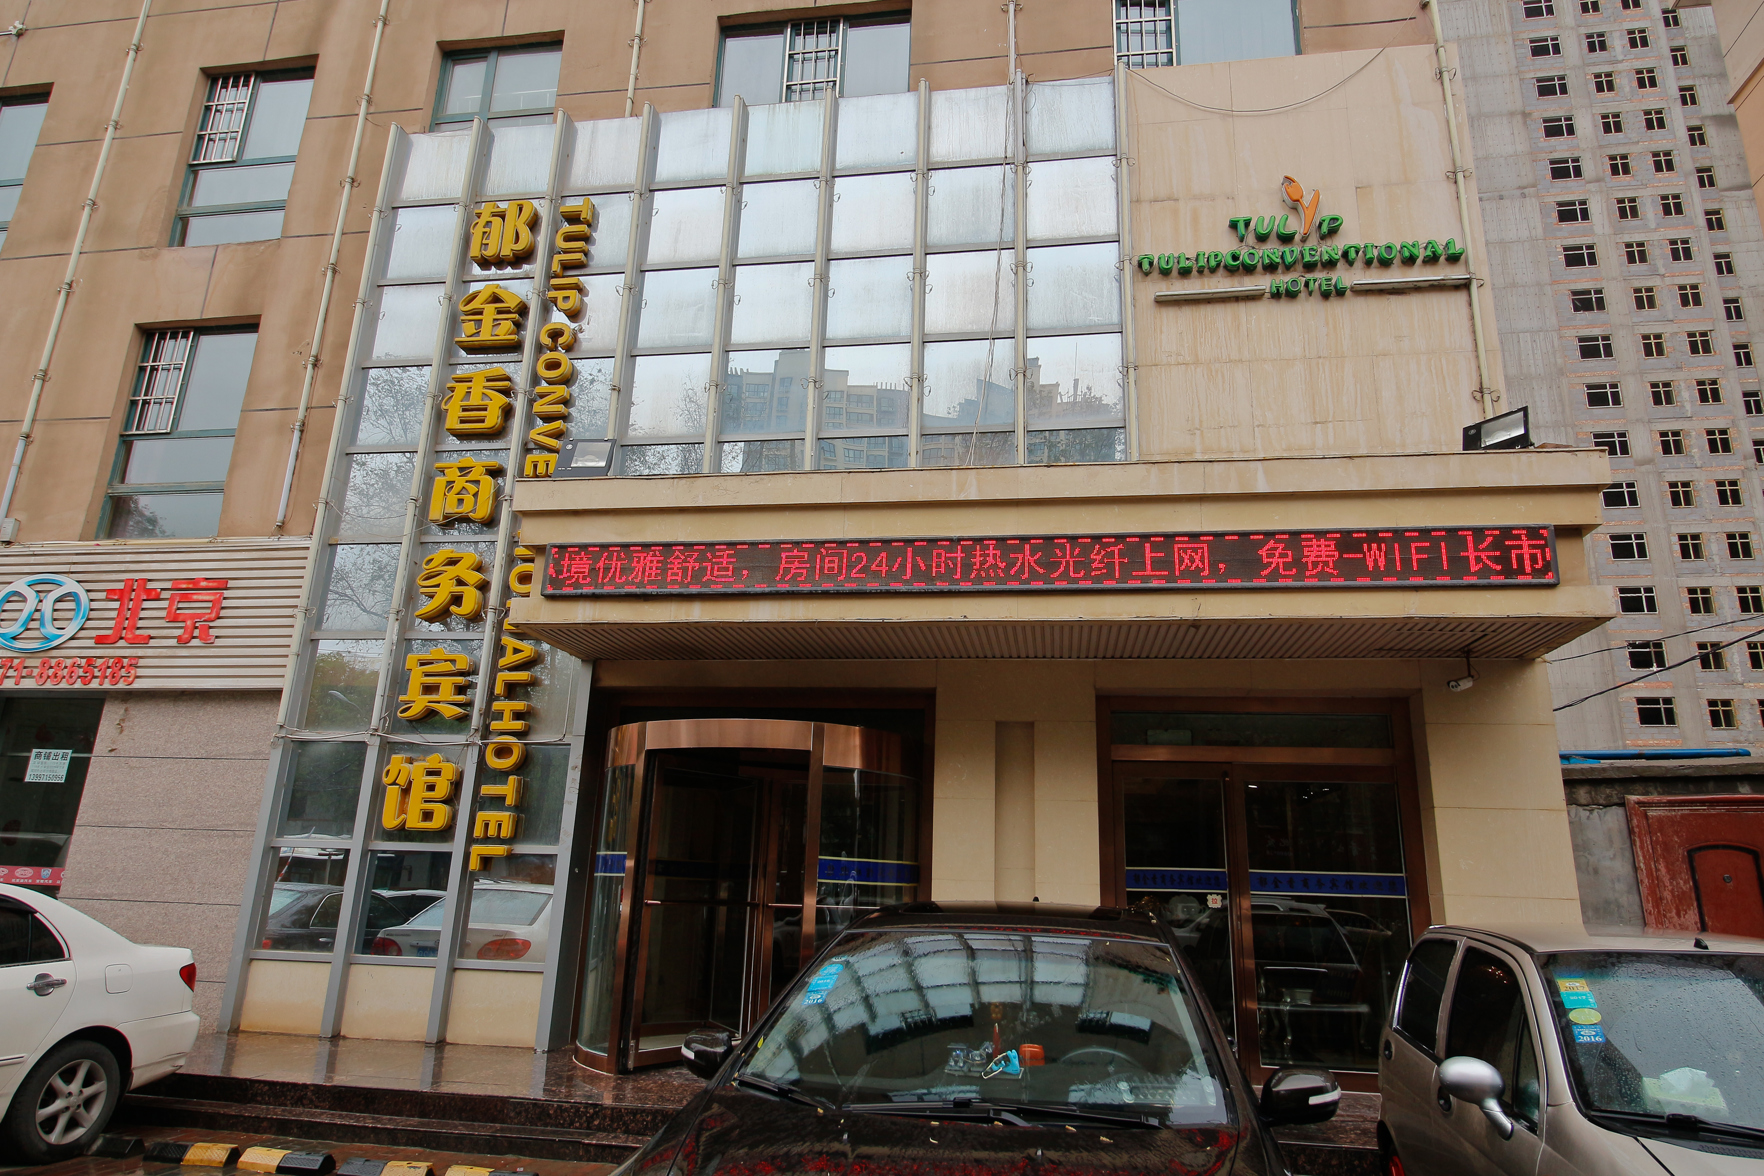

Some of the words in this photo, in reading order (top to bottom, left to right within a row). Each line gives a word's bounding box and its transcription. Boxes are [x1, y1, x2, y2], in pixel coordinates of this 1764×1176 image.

[549, 196, 595, 318] TULIP
[1269, 275, 1349, 299] HOTEL
[382, 199, 540, 832] 郁金香商务宾馆
[94, 577, 229, 645] 北京
[33, 750, 70, 761] 商铺出租
